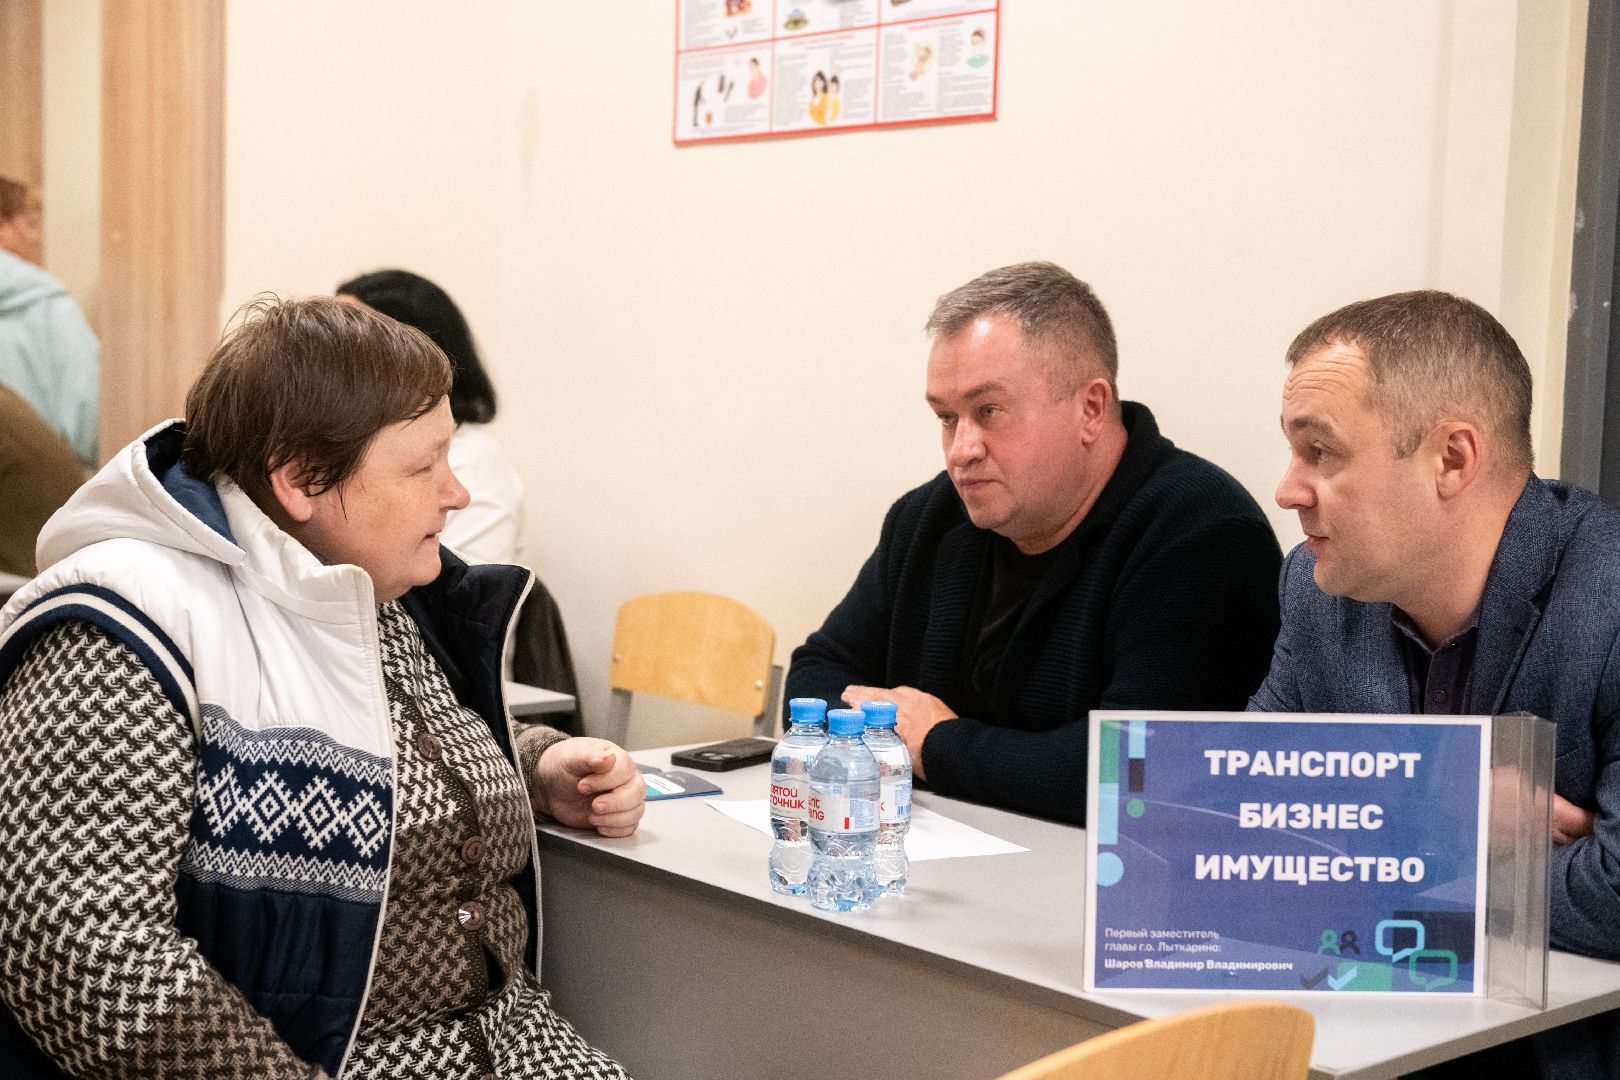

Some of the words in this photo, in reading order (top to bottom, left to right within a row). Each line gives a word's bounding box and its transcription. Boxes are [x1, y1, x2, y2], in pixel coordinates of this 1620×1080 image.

[1203, 749, 1422, 778] ТРАНСПОРТ
[1239, 802, 1384, 830] БИЗНЕС
[1195, 854, 1425, 886] ИМУЩЕСТВО
[1104, 927, 1148, 939] Первый
[1150, 929, 1220, 939] заместитель
[1104, 943, 1137, 952] главы
[1139, 943, 1154, 952] г.о.
[1157, 942, 1222, 953] Лыткарино:
[1104, 958, 1145, 970] Шаров
[1146, 959, 1205, 970] Владимир
[1206, 959, 1293, 972] Владимирович
